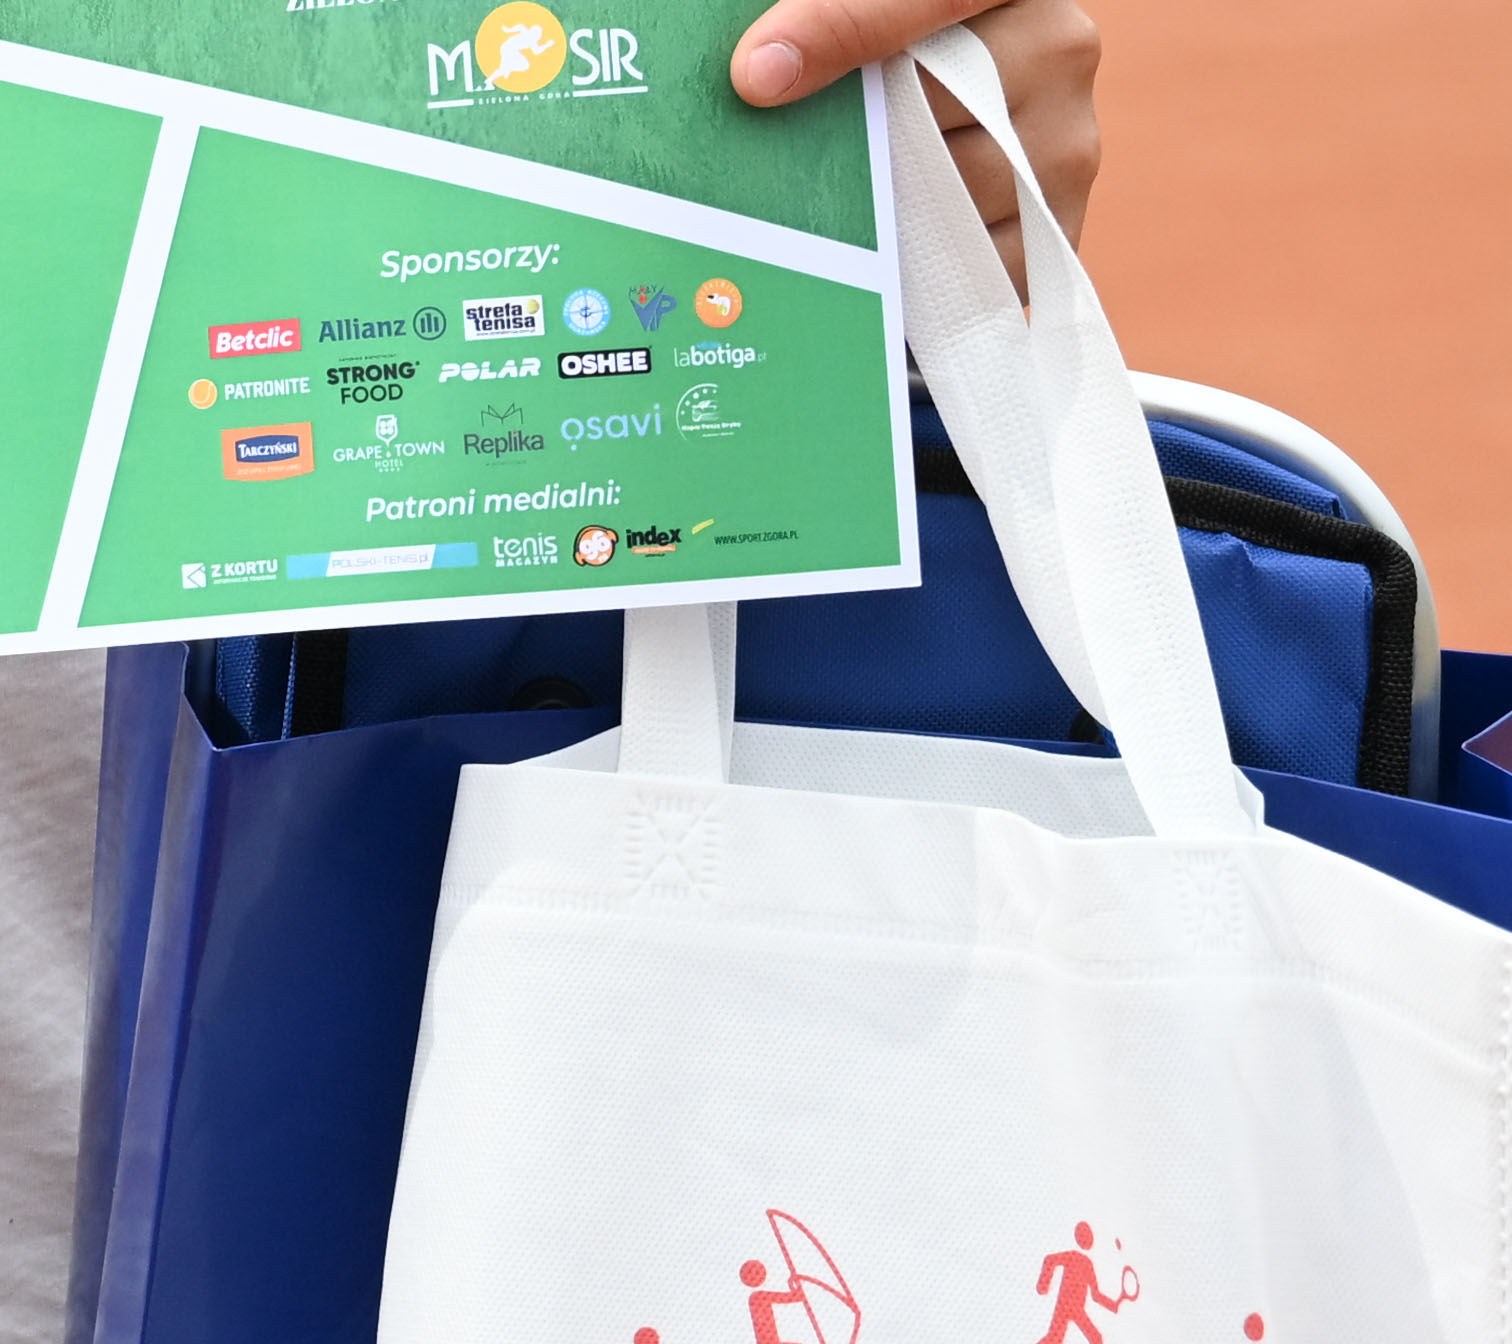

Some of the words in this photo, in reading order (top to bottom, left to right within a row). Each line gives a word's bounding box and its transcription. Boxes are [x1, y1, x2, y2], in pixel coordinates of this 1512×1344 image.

[380, 242, 561, 282] Sponsorzy:
[466, 302, 523, 320] strefa
[318, 318, 407, 343] Allianz
[475, 315, 535, 332] tenisa
[215, 326, 294, 353] Betclic
[326, 362, 416, 385] STRONG
[438, 357, 542, 383] POLAR
[561, 350, 648, 376] OSHEE
[224, 377, 310, 400] PATRONITE
[340, 384, 404, 404] FOOD
[560, 403, 662, 452] osavi
[333, 445, 382, 463] GRAPE
[393, 440, 445, 458] TOWN
[464, 430, 544, 458] Replika
[375, 458, 403, 468] HOTEL
[366, 488, 476, 522] Patroni
[484, 481, 621, 513] medialni:
[493, 532, 557, 558] tenis
[626, 525, 682, 548] index
[211, 564, 221, 578] Z
[224, 558, 278, 576] KORTU
[496, 555, 558, 567] MAGAZYN
